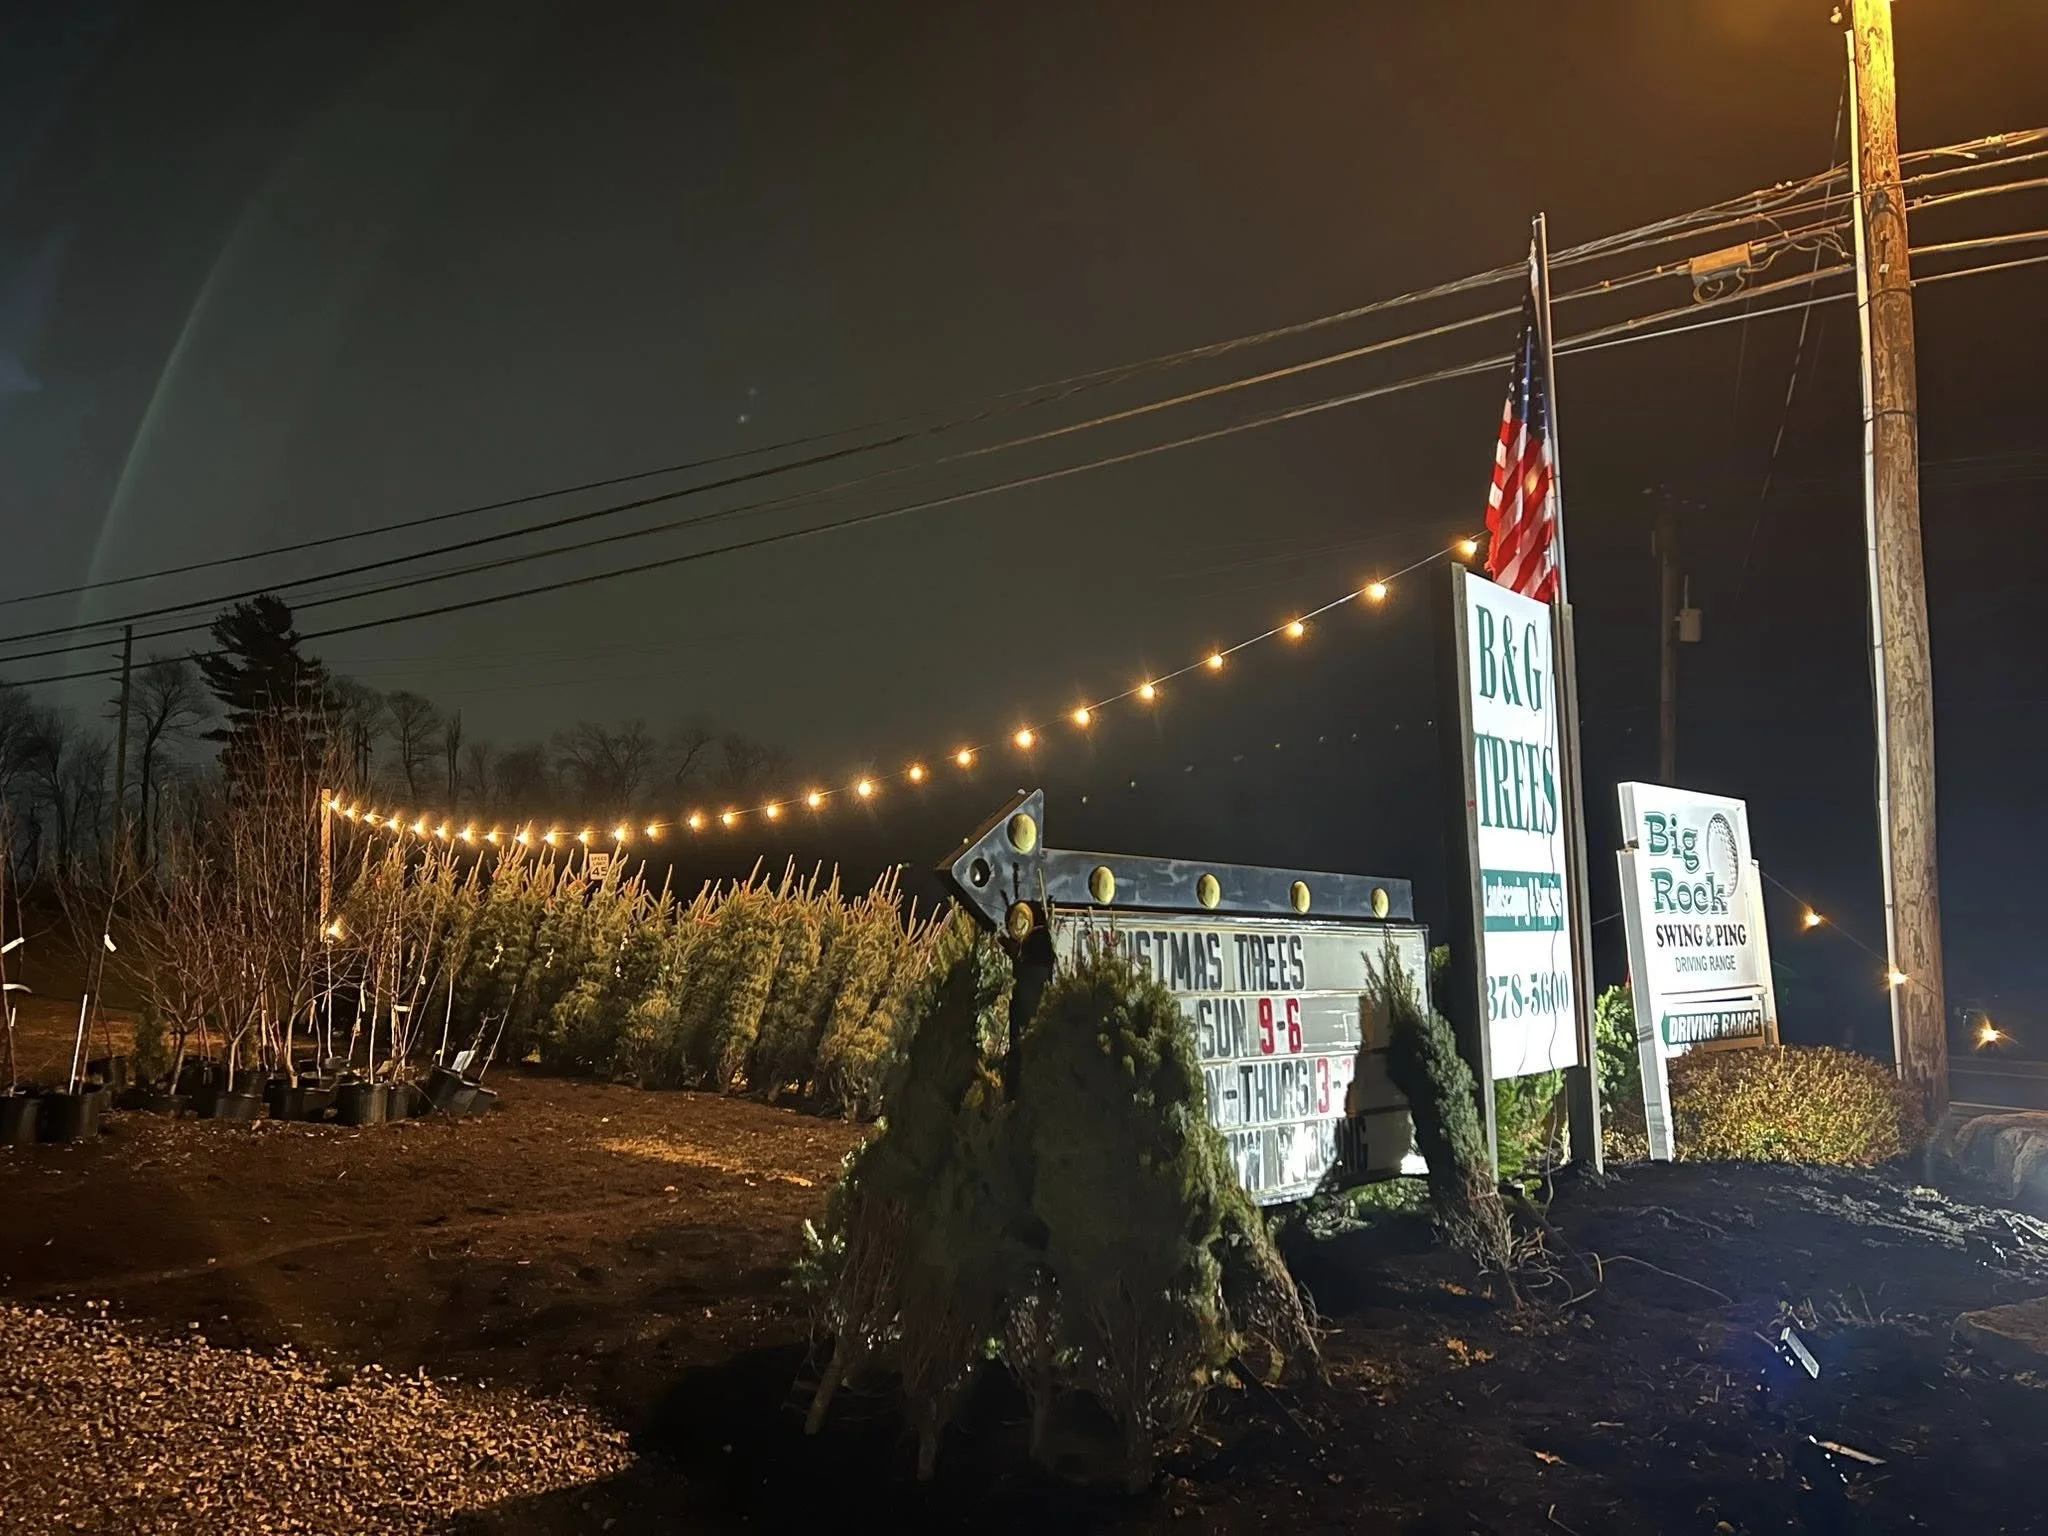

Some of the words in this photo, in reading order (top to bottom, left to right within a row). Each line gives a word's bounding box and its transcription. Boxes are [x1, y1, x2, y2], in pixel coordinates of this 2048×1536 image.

[1475, 604, 1543, 712] B&G
[1473, 731, 1557, 835] TREES
[1643, 811, 1700, 874] Big
[591, 866, 608, 877] 45
[1649, 867, 1729, 915] Rock
[1233, 934, 1306, 990] TREES
[1655, 923, 1703, 948] SWING
[1705, 925, 1715, 947] &
[1715, 924, 1747, 947] PING
[1675, 957, 1707, 973] DRIVING
[1709, 954, 1737, 971] RANGE
[1487, 970, 1569, 1022] 378-5600
[1258, 997, 1304, 1056] 9-6
[1668, 1012, 1720, 1044] DRIVING
[1721, 1010, 1760, 1038] RANGE
[1205, 1058, 1310, 1130] N-THURS
